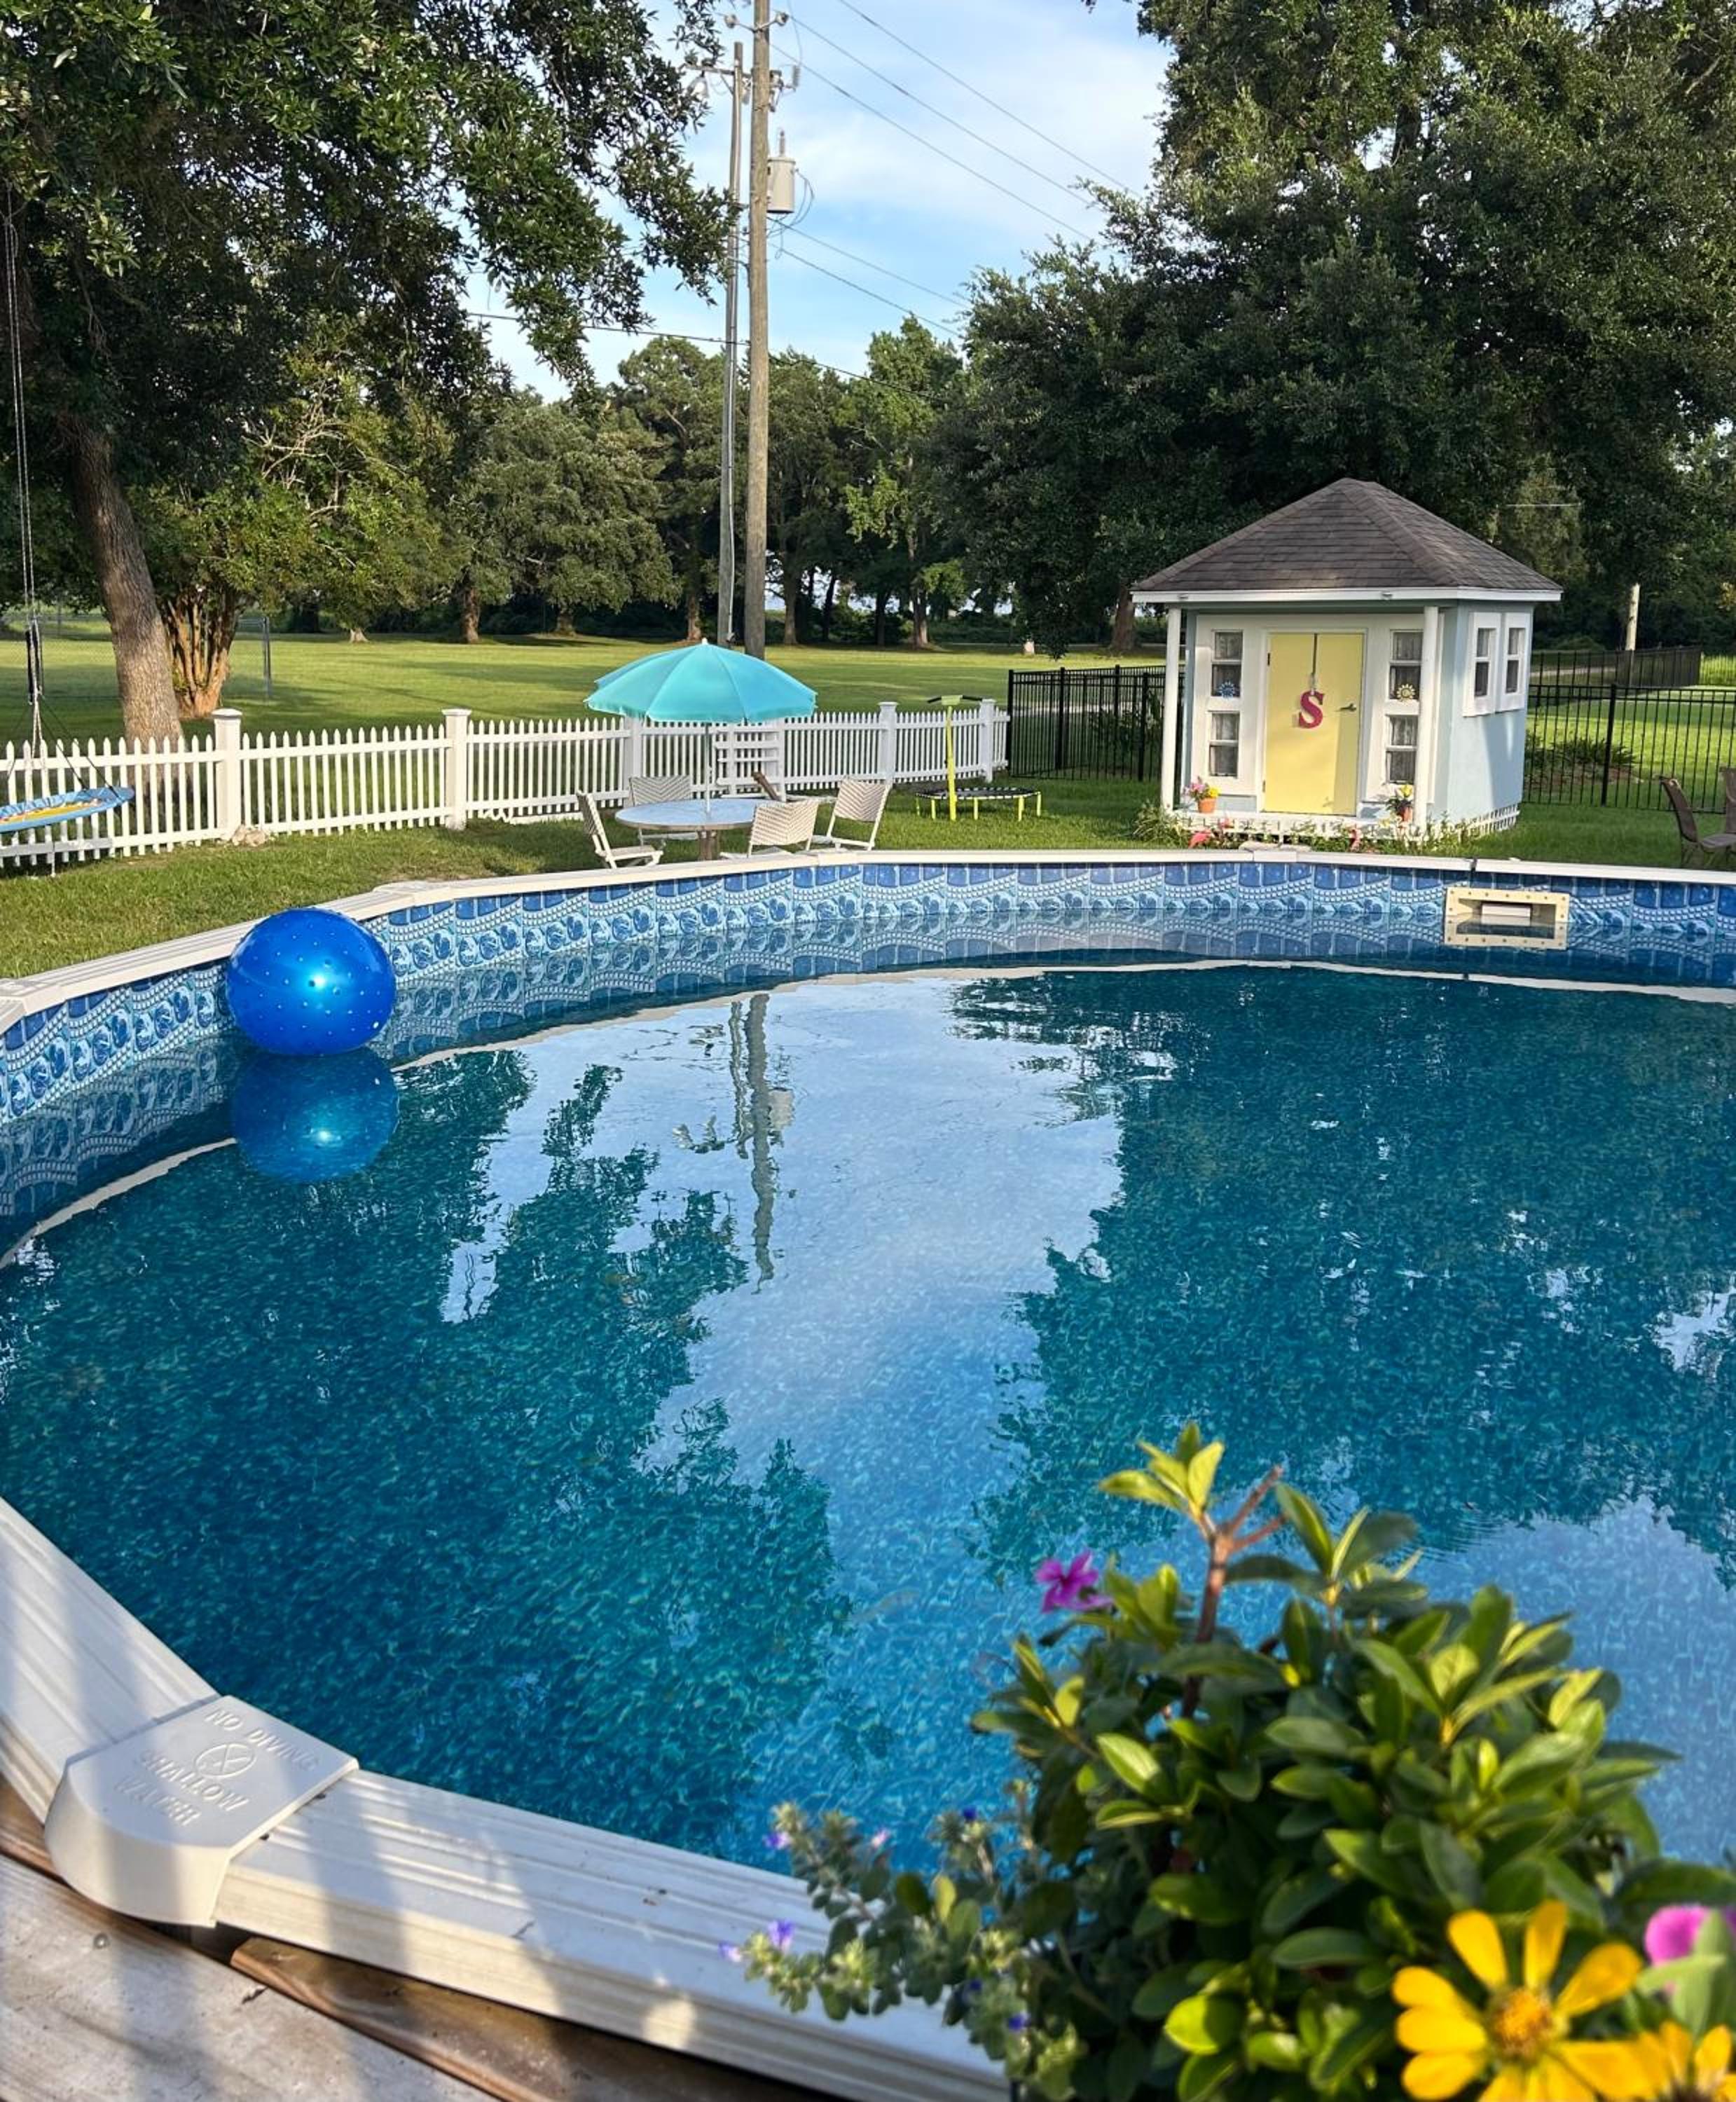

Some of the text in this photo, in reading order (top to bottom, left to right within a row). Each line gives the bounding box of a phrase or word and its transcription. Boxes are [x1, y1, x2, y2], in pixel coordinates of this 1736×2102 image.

[1298, 690, 1324, 729] S
[204, 1708, 319, 1771] NO DIVING
[137, 1750, 250, 1812] SHALLOW
